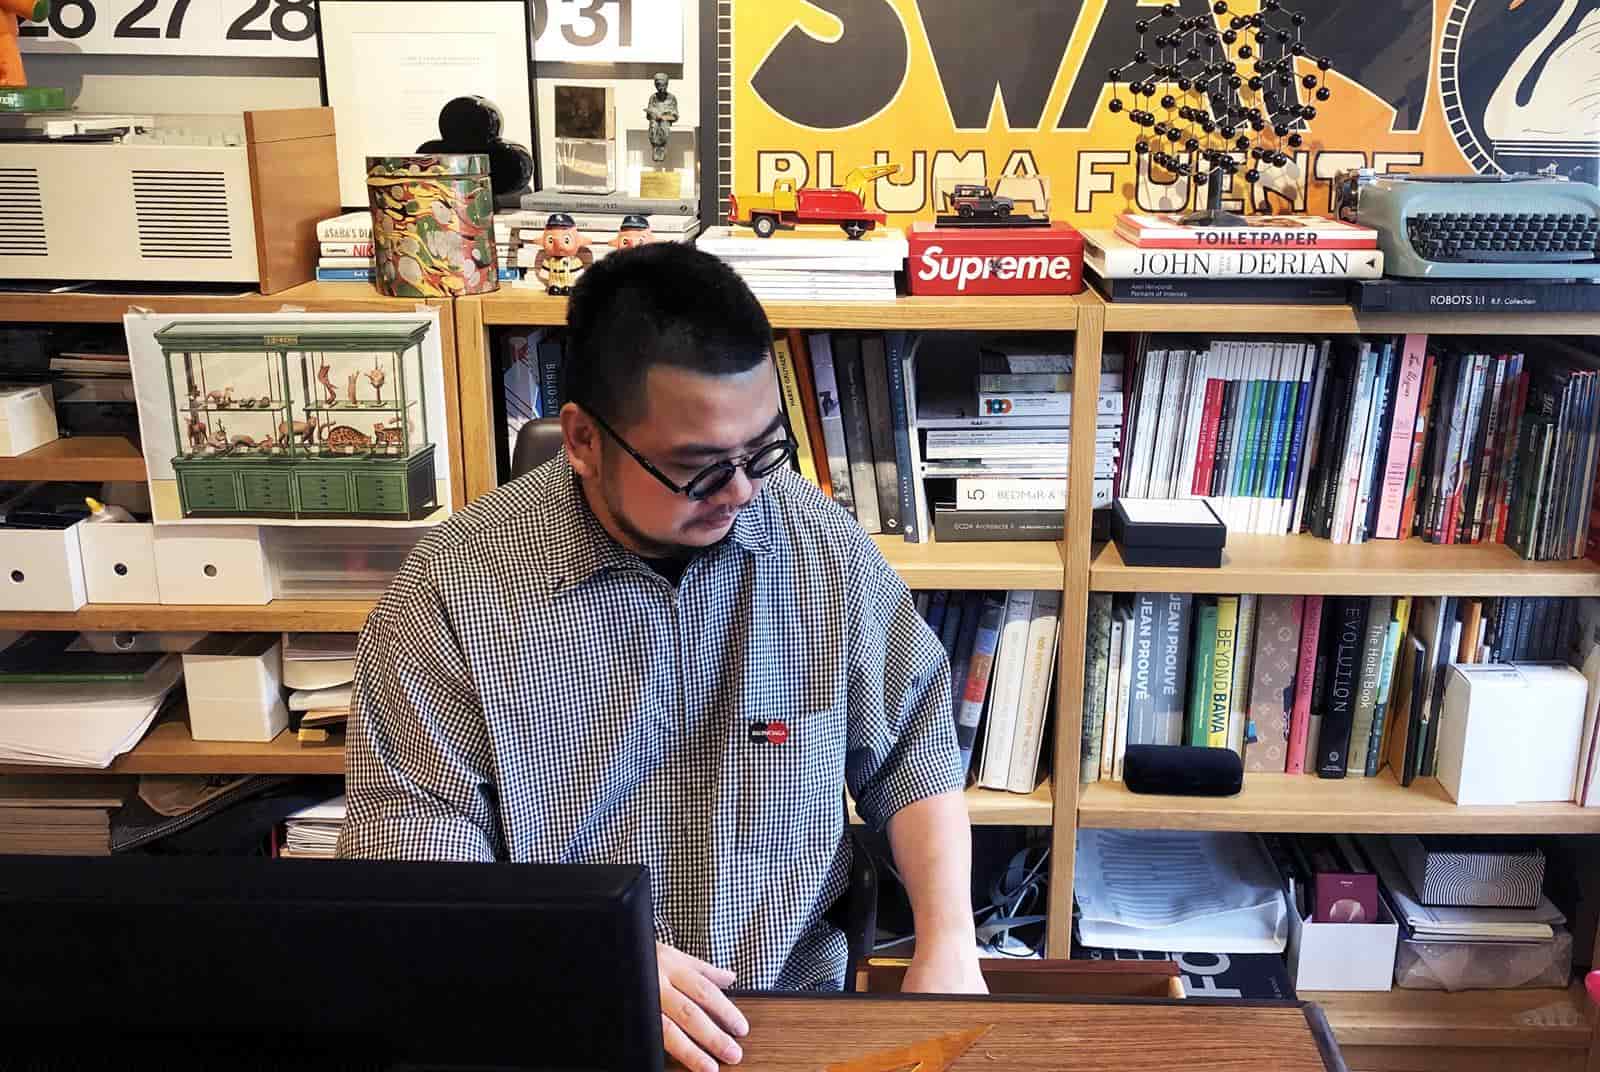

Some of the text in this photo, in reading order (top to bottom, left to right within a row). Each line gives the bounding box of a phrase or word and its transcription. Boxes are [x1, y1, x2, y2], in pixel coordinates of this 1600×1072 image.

[113, 0, 190, 39] 27
[226, 0, 320, 41] 28
[1194, 231, 1318, 246] TOILETPAPER
[918, 246, 1070, 291] Supreme
[1133, 251, 1211, 276] JOHN
[1239, 251, 1350, 276] DERIAN
[1430, 295, 1473, 305] ROBOTS
[1138, 598, 1153, 637] JEAN
[1167, 593, 1181, 637] JEAN
[1334, 608, 1361, 712] EVOLUTION
[1360, 624, 1384, 709] The Hotel Book
[1211, 629, 1233, 734] BEYOND BAWA
